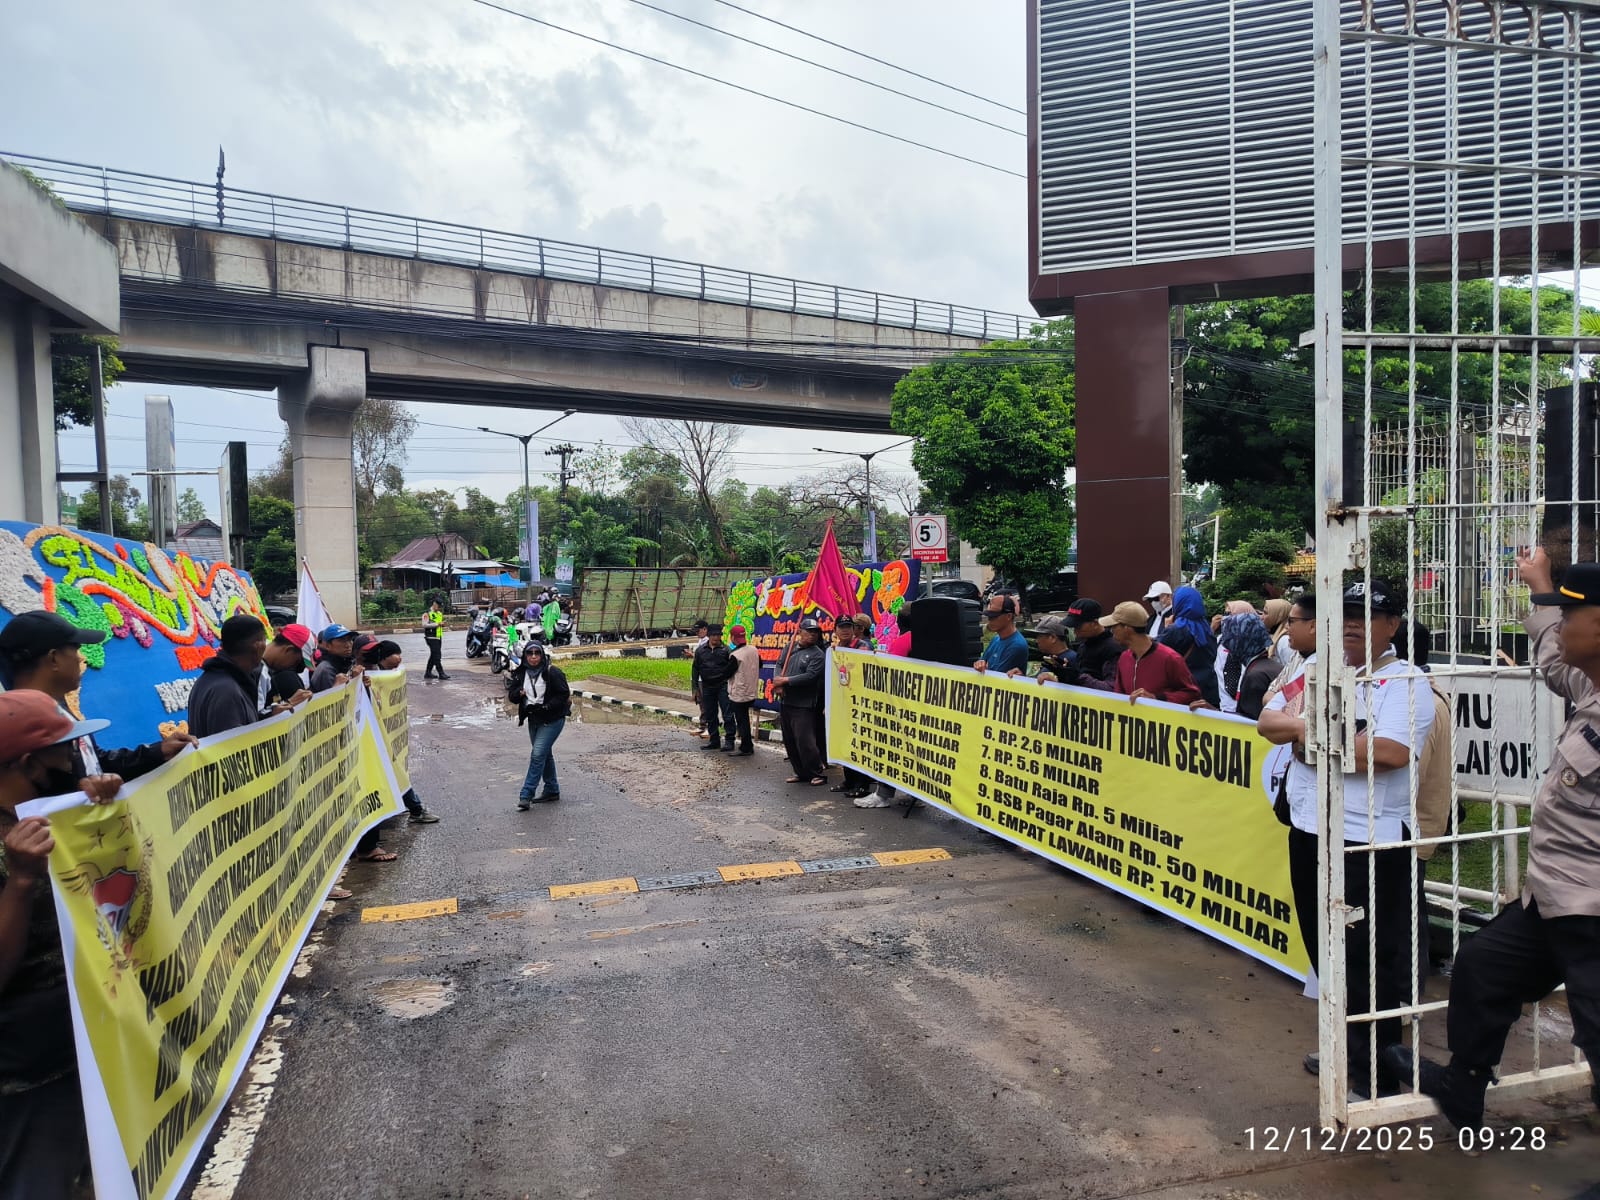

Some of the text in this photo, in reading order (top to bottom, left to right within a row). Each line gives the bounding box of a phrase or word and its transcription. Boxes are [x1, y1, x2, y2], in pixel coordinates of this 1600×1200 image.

[920, 525, 930, 542] 5
[850, 694, 859, 706] 1.
[872, 700, 884, 712] CF
[898, 706, 917, 723] 145
[919, 714, 962, 736] MILIAR
[860, 712, 872, 724] PT.
[874, 715, 888, 730] MA
[918, 730, 960, 753] MILIAR
[890, 668, 924, 702] MACET
[924, 675, 948, 710] DAN
[949, 680, 992, 718] KREDIT
[993, 688, 1030, 728] FIKTIF
[1030, 696, 1058, 736] DAN
[1060, 702, 1115, 751] KREDIT
[1118, 714, 1172, 768] TIDAK
[1175, 726, 1252, 788] SESUAI
[1447, 693, 1492, 730] MU
[860, 726, 872, 740] PT.
[874, 730, 888, 744] TM
[890, 735, 903, 750] RP.
[916, 746, 956, 770] MILIAR
[860, 740, 872, 754] PT.
[873, 745, 886, 758] KP
[888, 750, 901, 766] RP.
[902, 756, 915, 770] 57
[916, 762, 952, 788] MILIAR
[981, 744, 1100, 796] 7. RP. 5.6 MILIAR
[983, 726, 1102, 774] 6. RP. 2,6 MILIAR
[1456, 740, 1539, 780] APOR
[190, 761, 220, 812] KEJATI
[219, 748, 254, 796] SUMSEL
[250, 738, 280, 778] UNTUK
[850, 751, 952, 806] 5. PT. CF RP. 50 MILIAR
[212, 800, 252, 858] RATUSAN
[980, 764, 1184, 850] 8. Batu Raja Rp. 5 Miliar
[976, 802, 1289, 955] 10. EMPAT LAWANG RP. 147 MILIAR
[978, 782, 1291, 924] 9. BSB Pagar Alam Rp. 50 MILIAR
[146, 1088, 190, 1194] UNTUK
